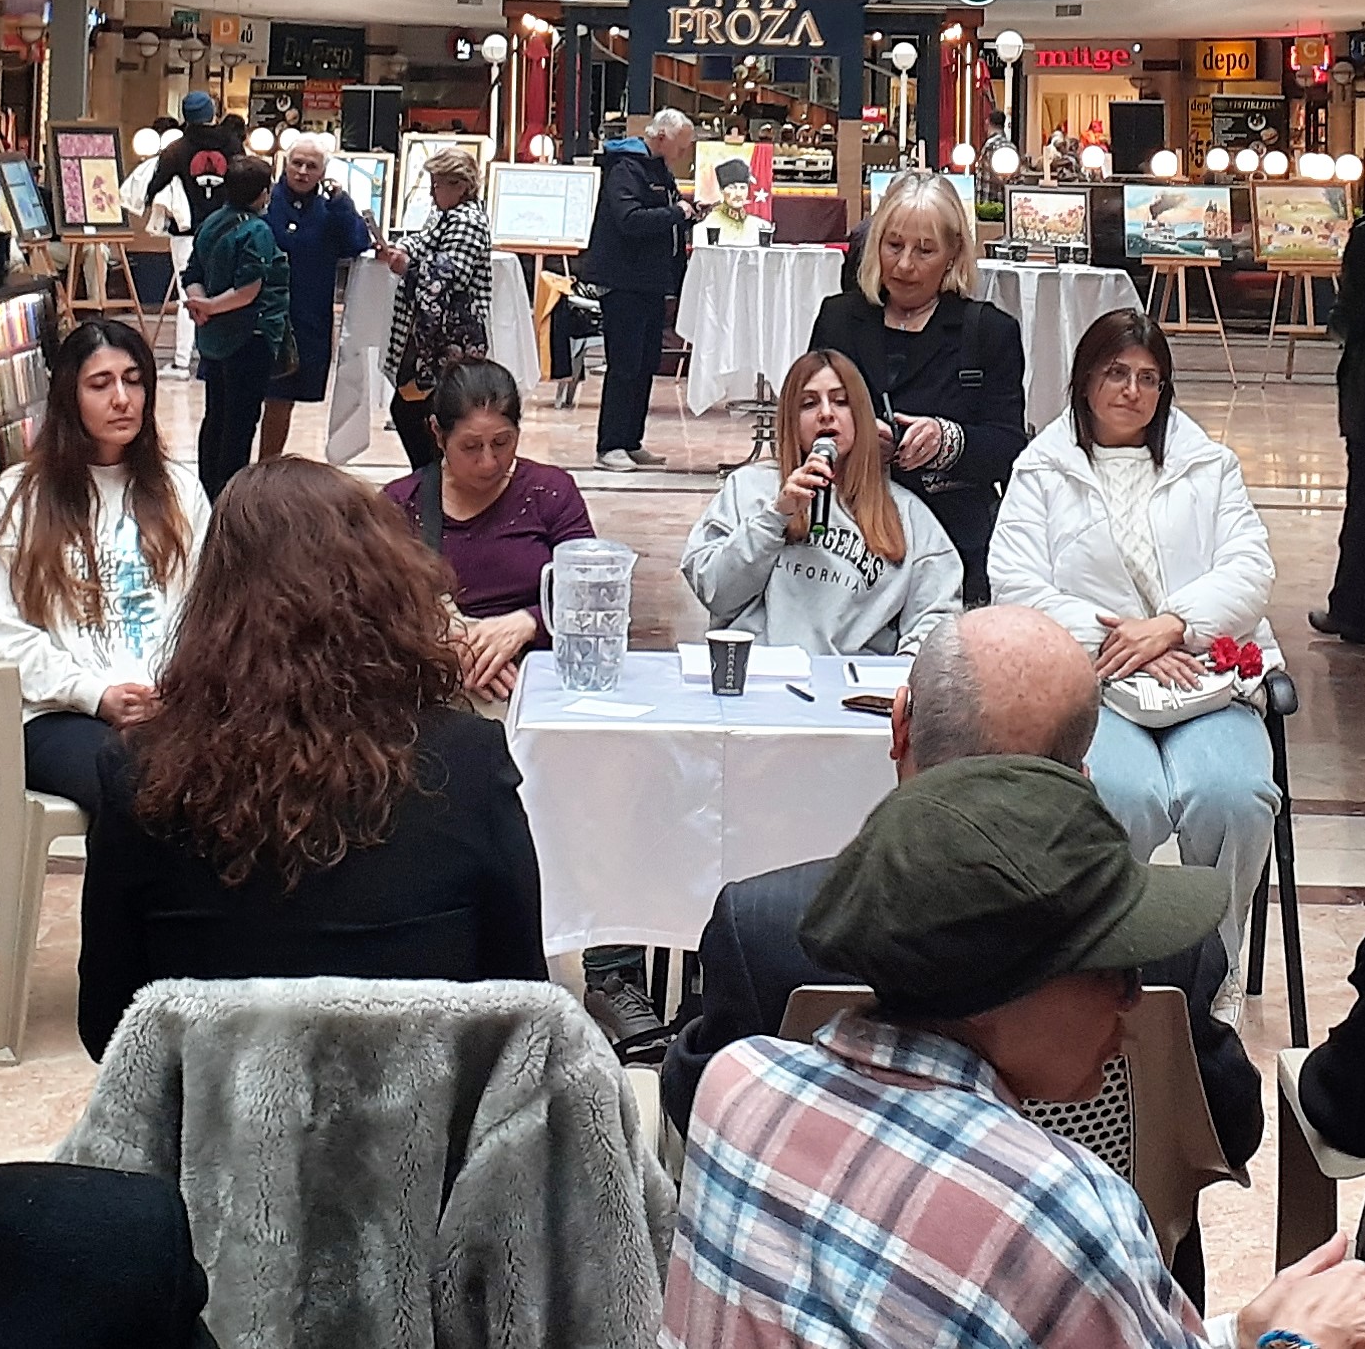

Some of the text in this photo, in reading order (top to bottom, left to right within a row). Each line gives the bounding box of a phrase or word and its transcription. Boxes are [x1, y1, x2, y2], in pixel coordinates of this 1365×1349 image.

[1202, 45, 1250, 76] depo
[774, 555, 862, 594] LIFORNIA
[807, 527, 884, 591] GELES
